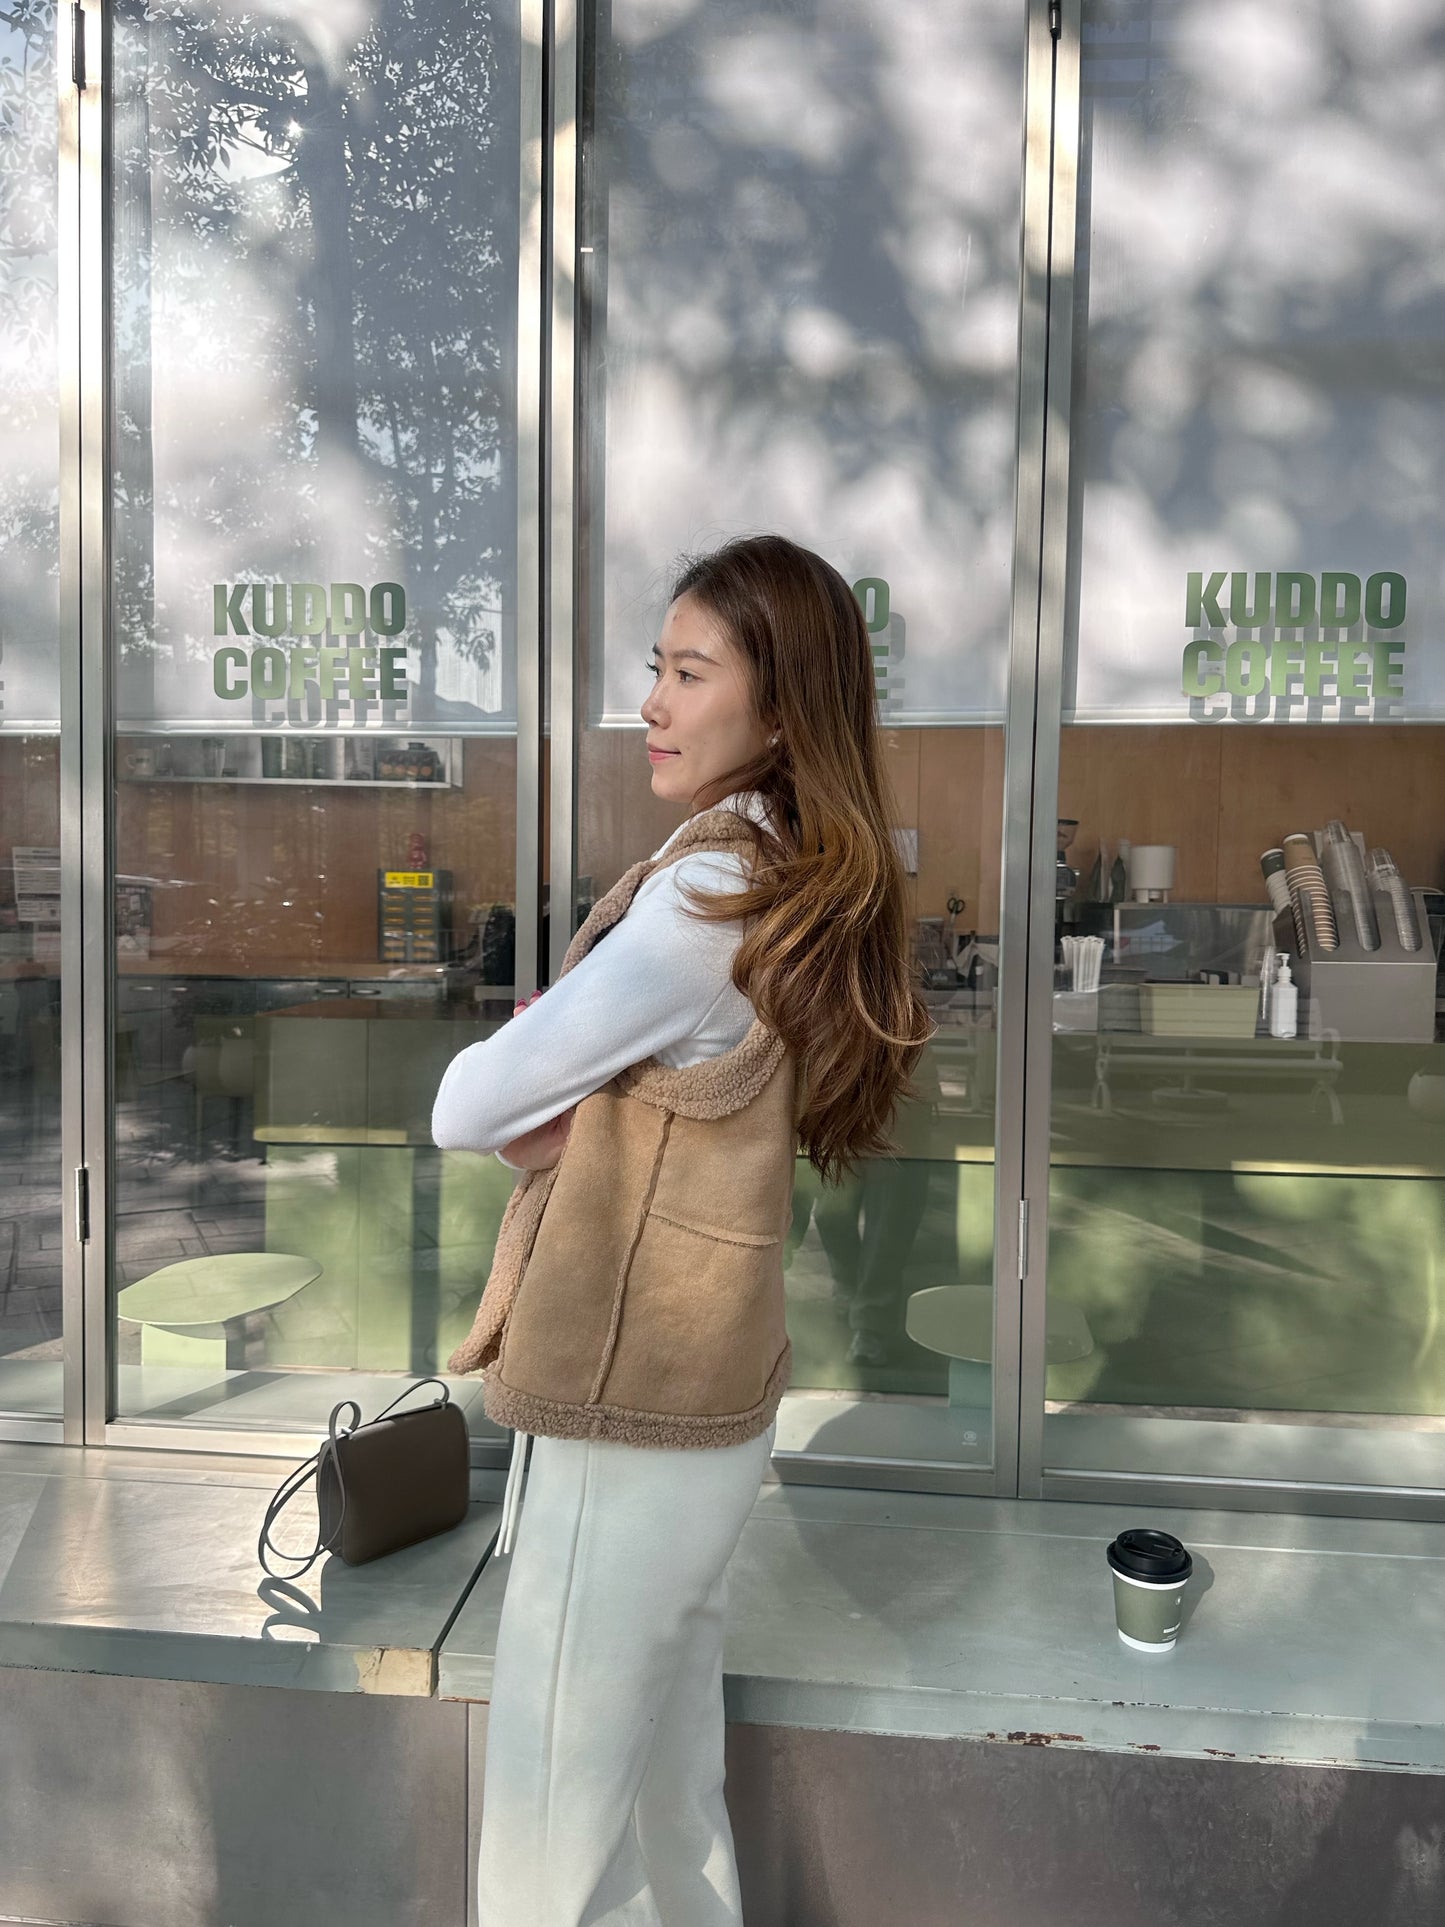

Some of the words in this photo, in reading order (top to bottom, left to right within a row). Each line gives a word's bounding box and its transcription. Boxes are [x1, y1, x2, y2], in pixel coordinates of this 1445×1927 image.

[213, 582, 406, 636] KUDDO
[1185, 571, 1407, 629] KUDDO
[213, 647, 407, 700] COFFEE
[1182, 640, 1406, 697] COFFEE
